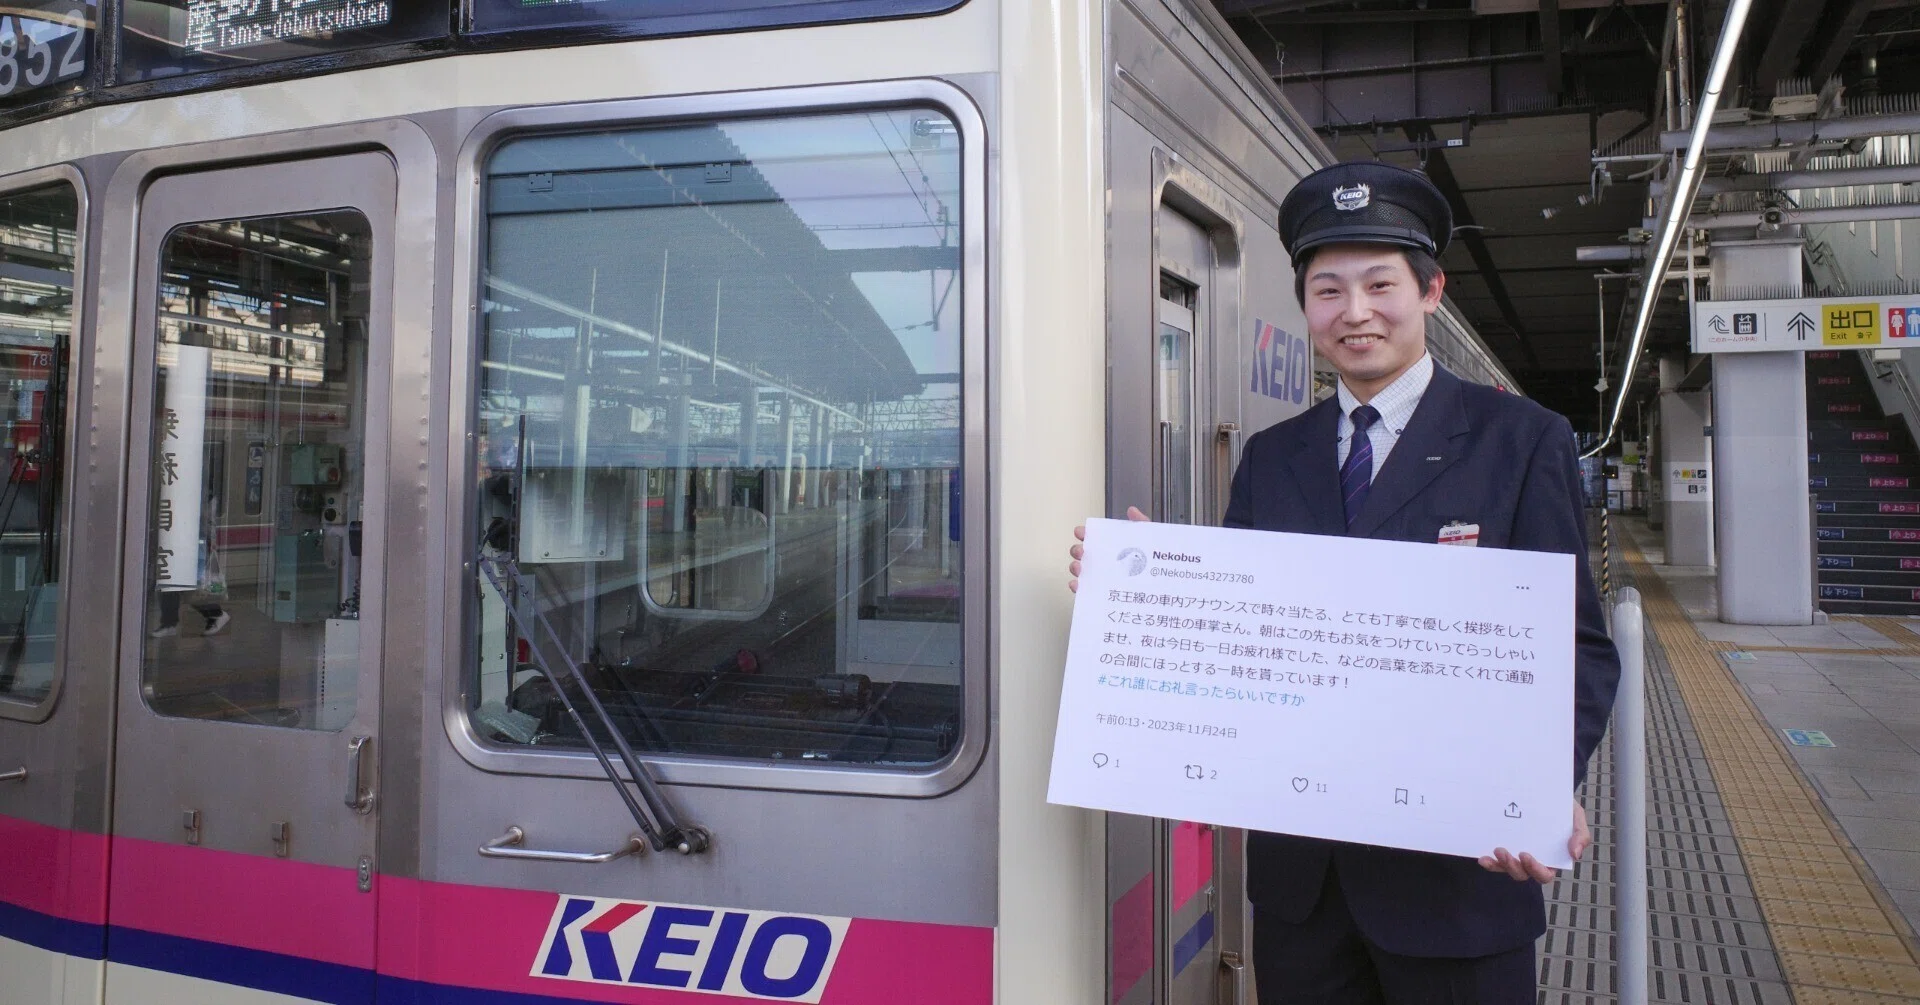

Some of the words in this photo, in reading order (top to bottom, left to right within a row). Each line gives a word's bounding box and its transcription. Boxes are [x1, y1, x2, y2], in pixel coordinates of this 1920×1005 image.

[1340, 191, 1363, 200] KEIO
[1831, 310, 1872, 328] 出口
[1831, 332, 1848, 340] Exit
[31, 353, 53, 367] 78
[1250, 318, 1305, 405] KEIO
[1892, 503, 1905, 512] 上り
[1903, 531, 1917, 539] 上り
[1152, 550, 1202, 563] Nekobus
[1150, 566, 1254, 584] @Nekobus43273780
[1836, 588, 1849, 596] 下り
[1107, 589, 1535, 640] 京王線の車内アナウンスで時々当たる、とても丁寧で優しく挨拶をして
[1107, 611, 1535, 661] くださる男性の車掌さん。朝はこの先もお気をつけていってらっしゃい
[1103, 631, 1534, 685] ませ、夜は今日も一日お疲れ様でした、などの言葉を添えてくれて通勤
[1098, 674, 1305, 707] #これ誰にお礼言ったらいいですか
[1114, 758, 1120, 768] 1
[1210, 769, 1218, 780] 2
[1315, 782, 1328, 793] 11
[1419, 794, 1425, 805] 1
[541, 898, 832, 998] KEIO
